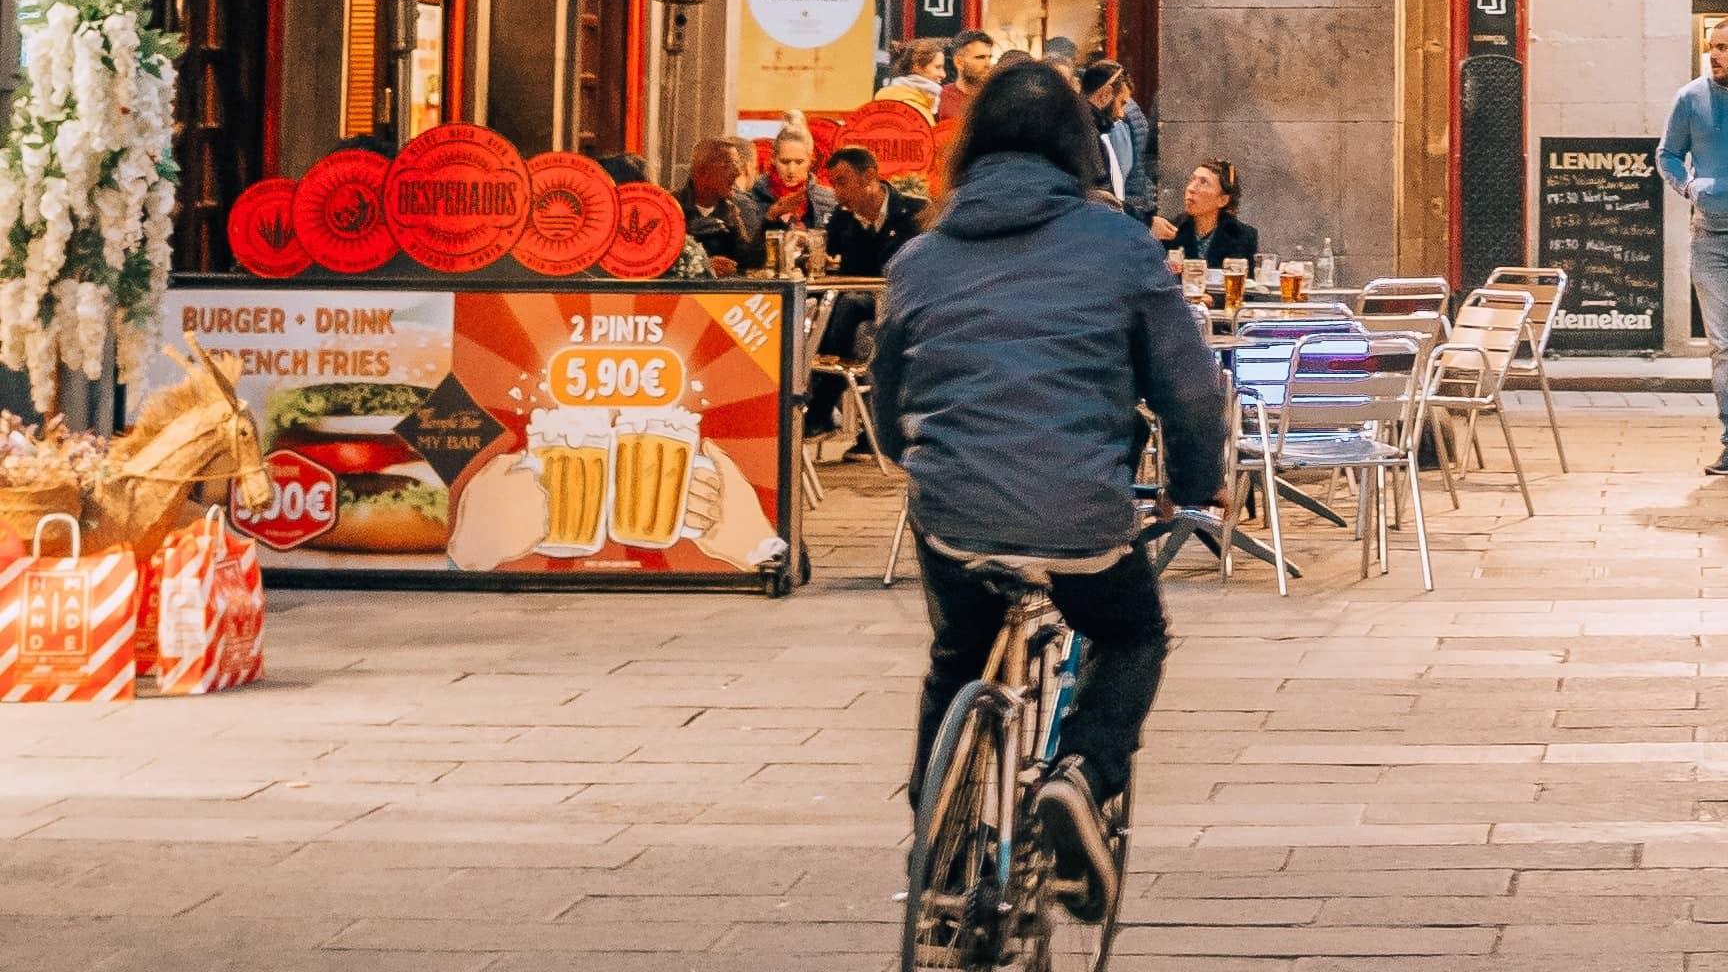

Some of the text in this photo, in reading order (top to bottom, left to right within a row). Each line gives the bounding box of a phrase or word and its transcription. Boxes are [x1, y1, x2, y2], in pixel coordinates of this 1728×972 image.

[1549, 151, 1649, 170] LENNOX
[398, 180, 518, 215] DESPERADOS
[182, 306, 286, 333] BURGER
[314, 307, 395, 334] DRINK
[743, 293, 780, 330] ALL
[570, 314, 664, 343] 2 PINTS
[722, 304, 769, 353] DAY!
[317, 348, 390, 377] FRIES
[566, 357, 666, 401] 5,90€
[445, 434, 481, 450] BAR
